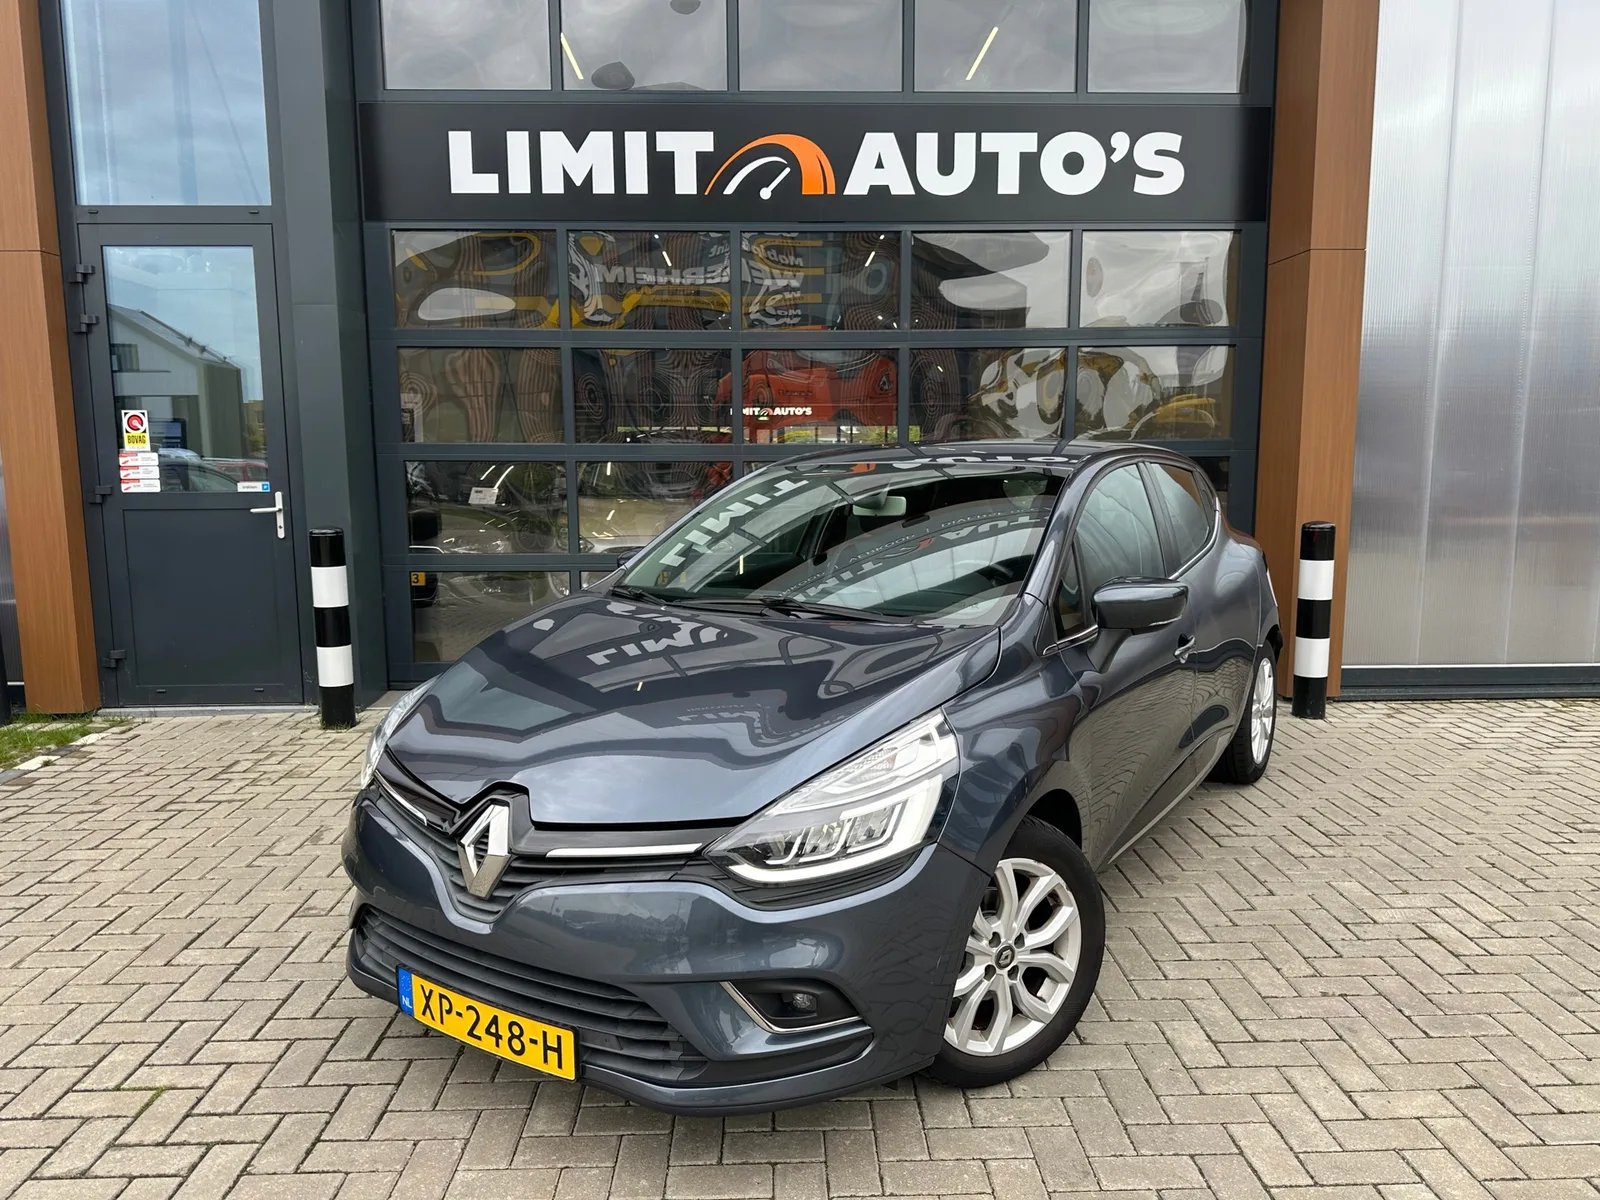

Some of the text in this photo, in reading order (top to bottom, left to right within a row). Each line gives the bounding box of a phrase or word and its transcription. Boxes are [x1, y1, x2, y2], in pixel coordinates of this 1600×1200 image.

[448, 130, 1185, 196] LIMIT AUTO'S
[773, 407, 812, 416] AUTO'S
[127, 435, 147, 444] BOVAG
[401, 995, 413, 1009] NL
[420, 984, 563, 1070] XP-248-H
